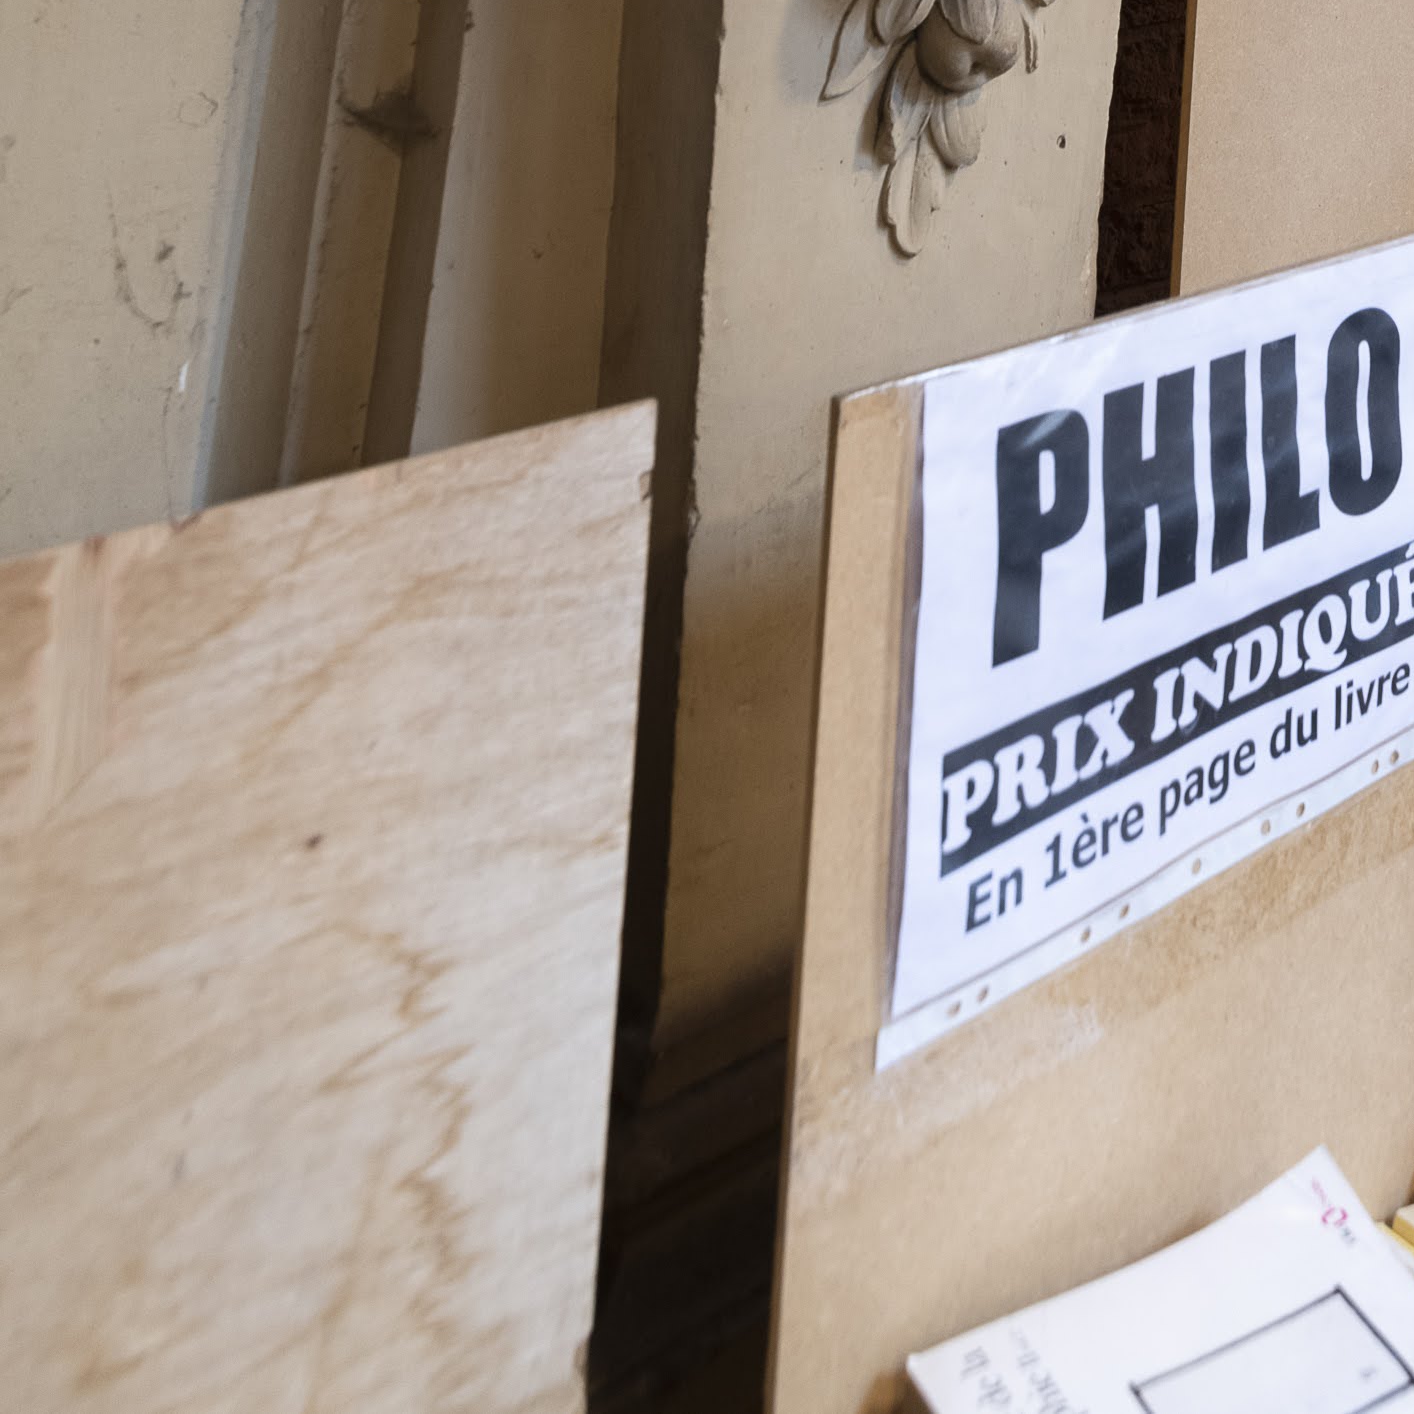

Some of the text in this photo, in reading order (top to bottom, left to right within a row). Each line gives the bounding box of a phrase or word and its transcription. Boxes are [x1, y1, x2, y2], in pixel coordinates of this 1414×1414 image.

[993, 307, 1400, 668] PHILO
[941, 697, 1134, 854] PRIX
[966, 661, 1412, 933] En 1ère page du livre
